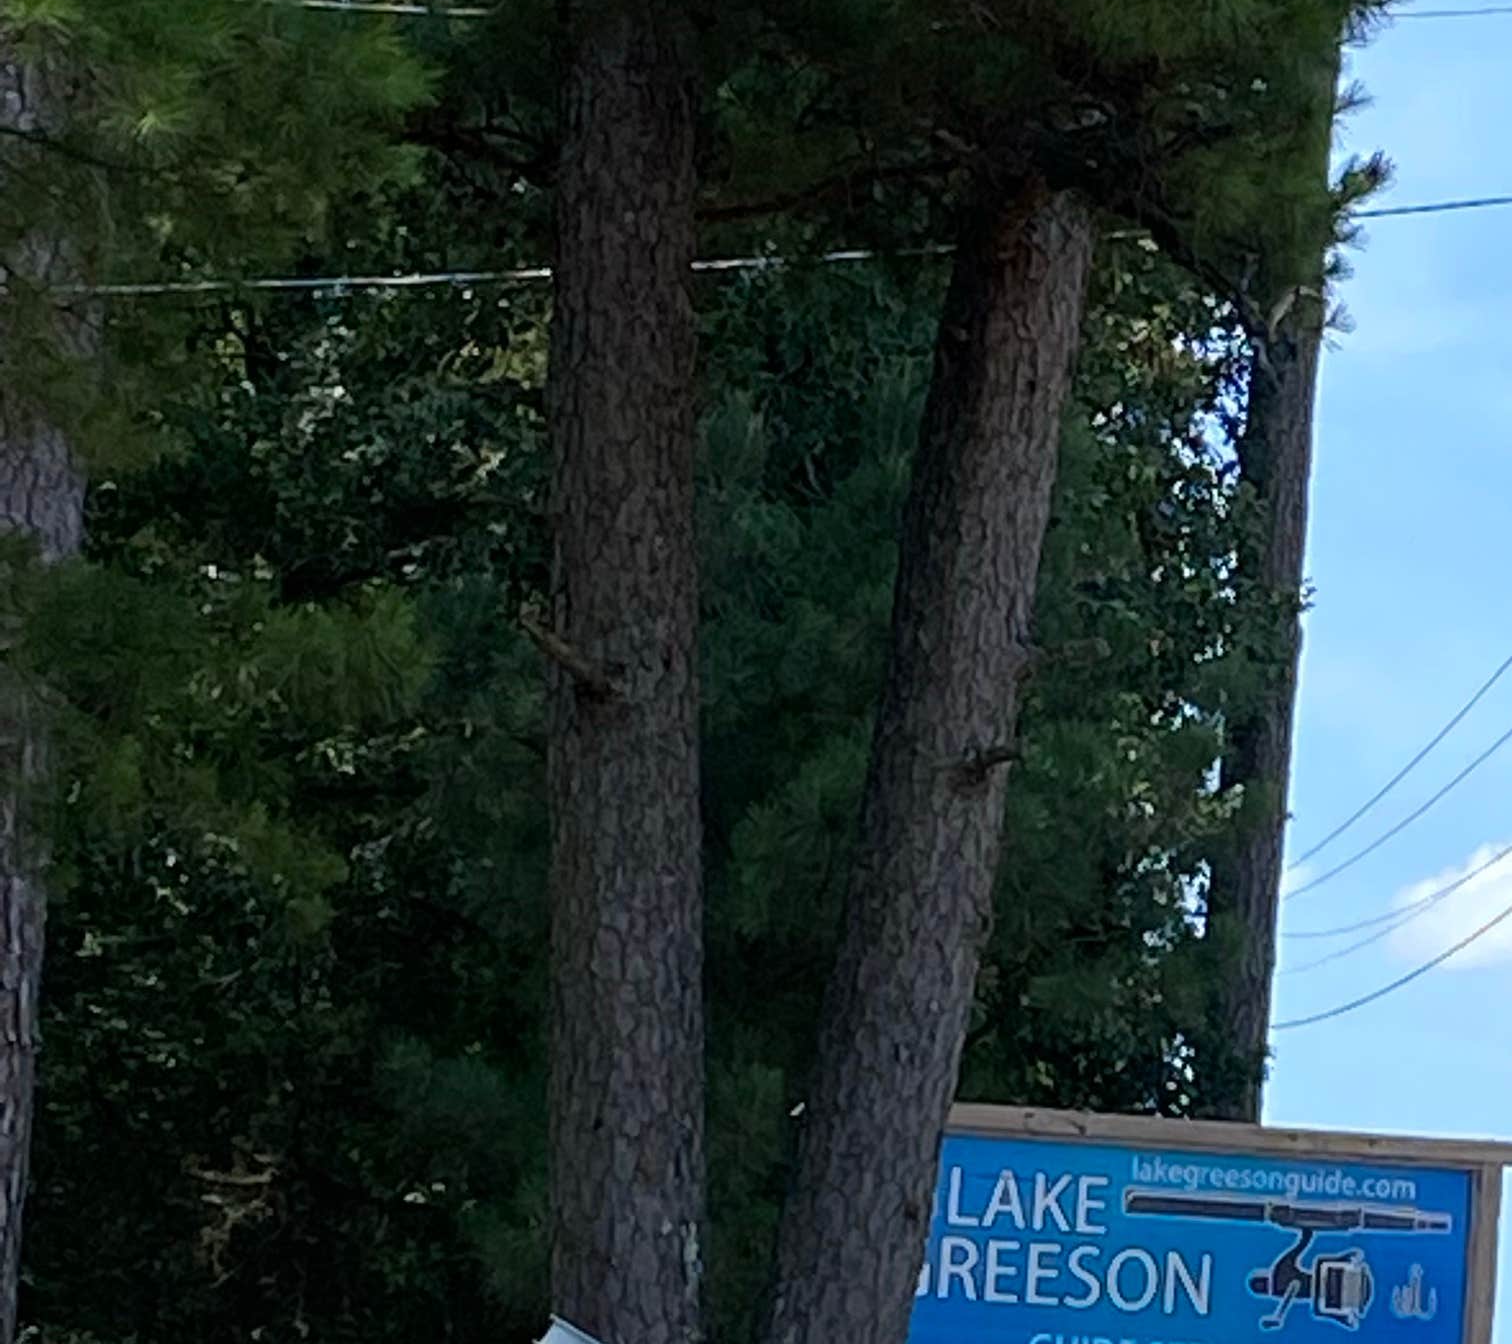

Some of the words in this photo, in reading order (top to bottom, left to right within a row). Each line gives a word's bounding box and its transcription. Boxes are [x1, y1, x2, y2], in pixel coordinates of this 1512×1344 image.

[947, 1166, 1109, 1235] LAKE
[1132, 1155, 1417, 1200] lakegreesonguide.com
[915, 1236, 1212, 1315] REESON
